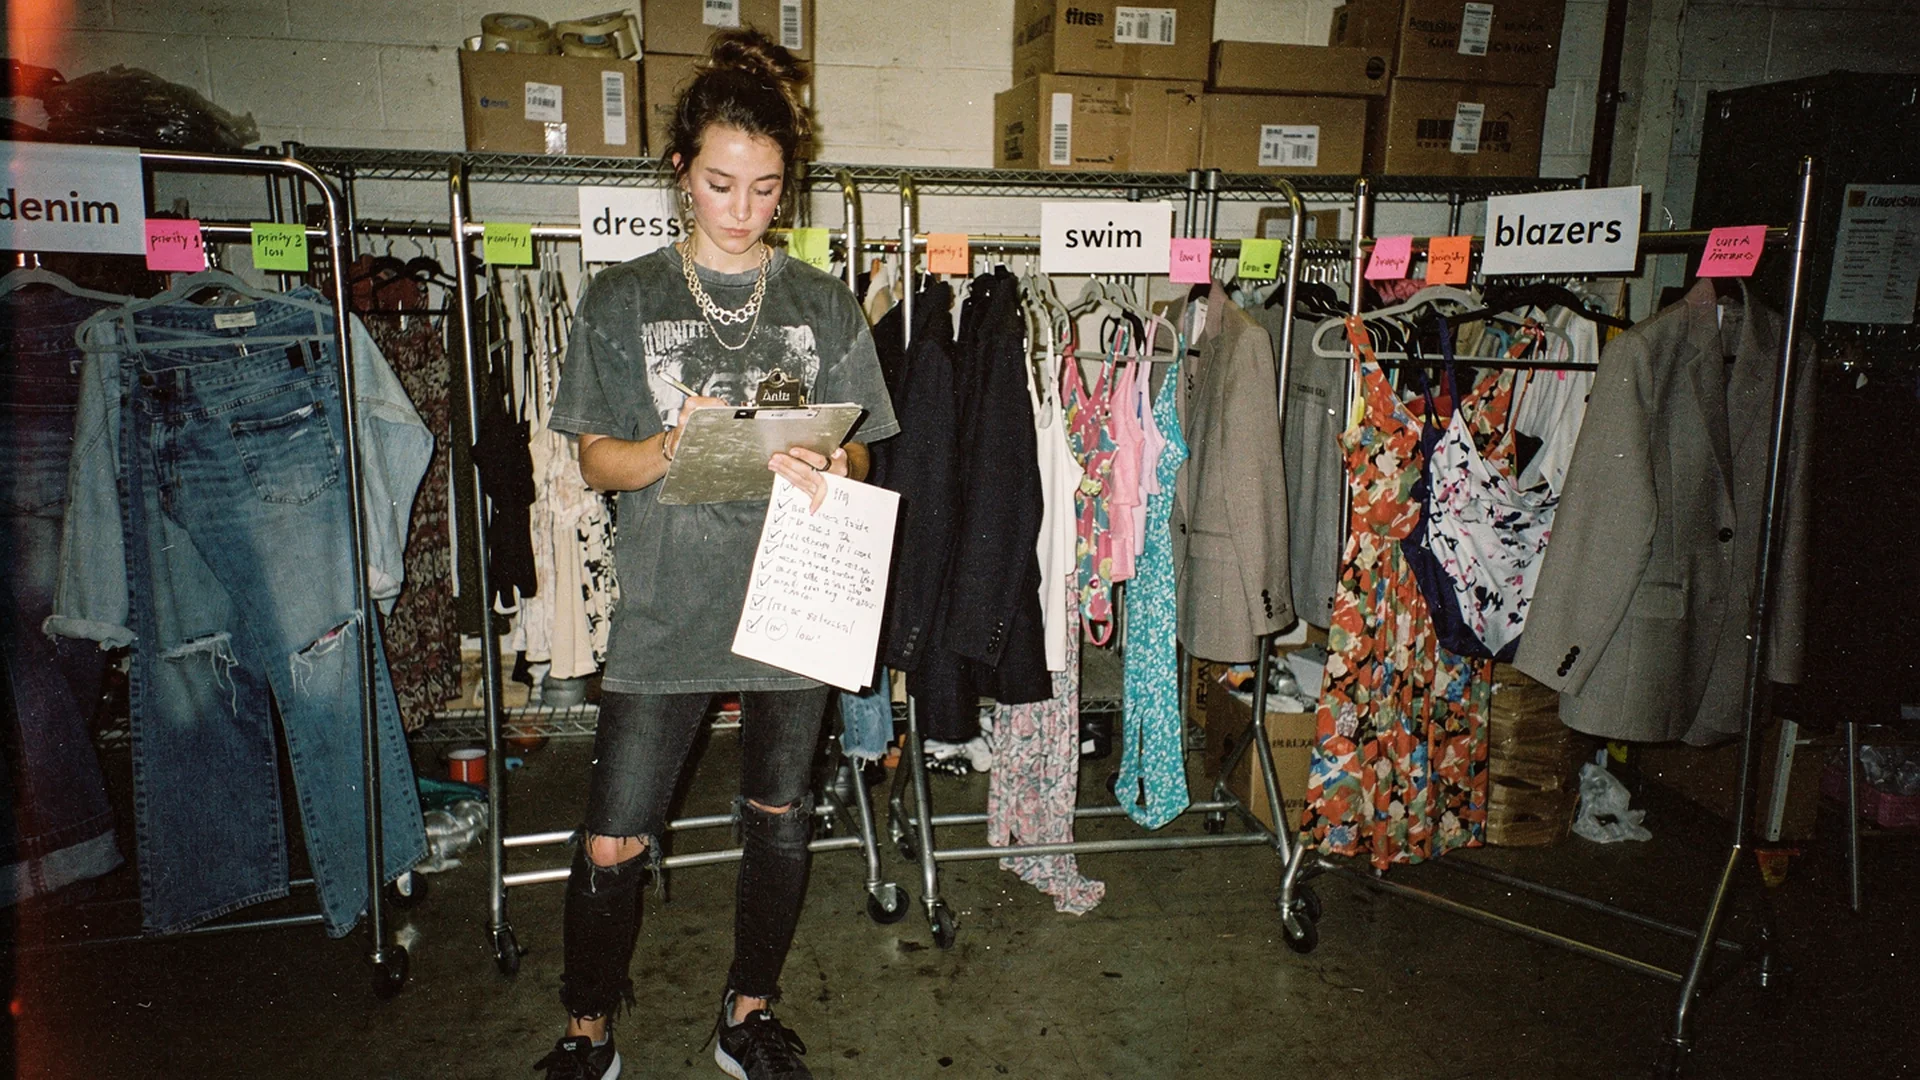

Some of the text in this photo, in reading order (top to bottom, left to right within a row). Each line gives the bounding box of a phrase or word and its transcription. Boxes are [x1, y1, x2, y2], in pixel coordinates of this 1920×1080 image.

[0, 188, 119, 224] denim
[593, 206, 696, 237] dresse
[1065, 220, 1142, 248] swim
[1495, 214, 1622, 247] blazers
[294, 235, 302, 247] 2
[1444, 262, 1452, 275] 2
